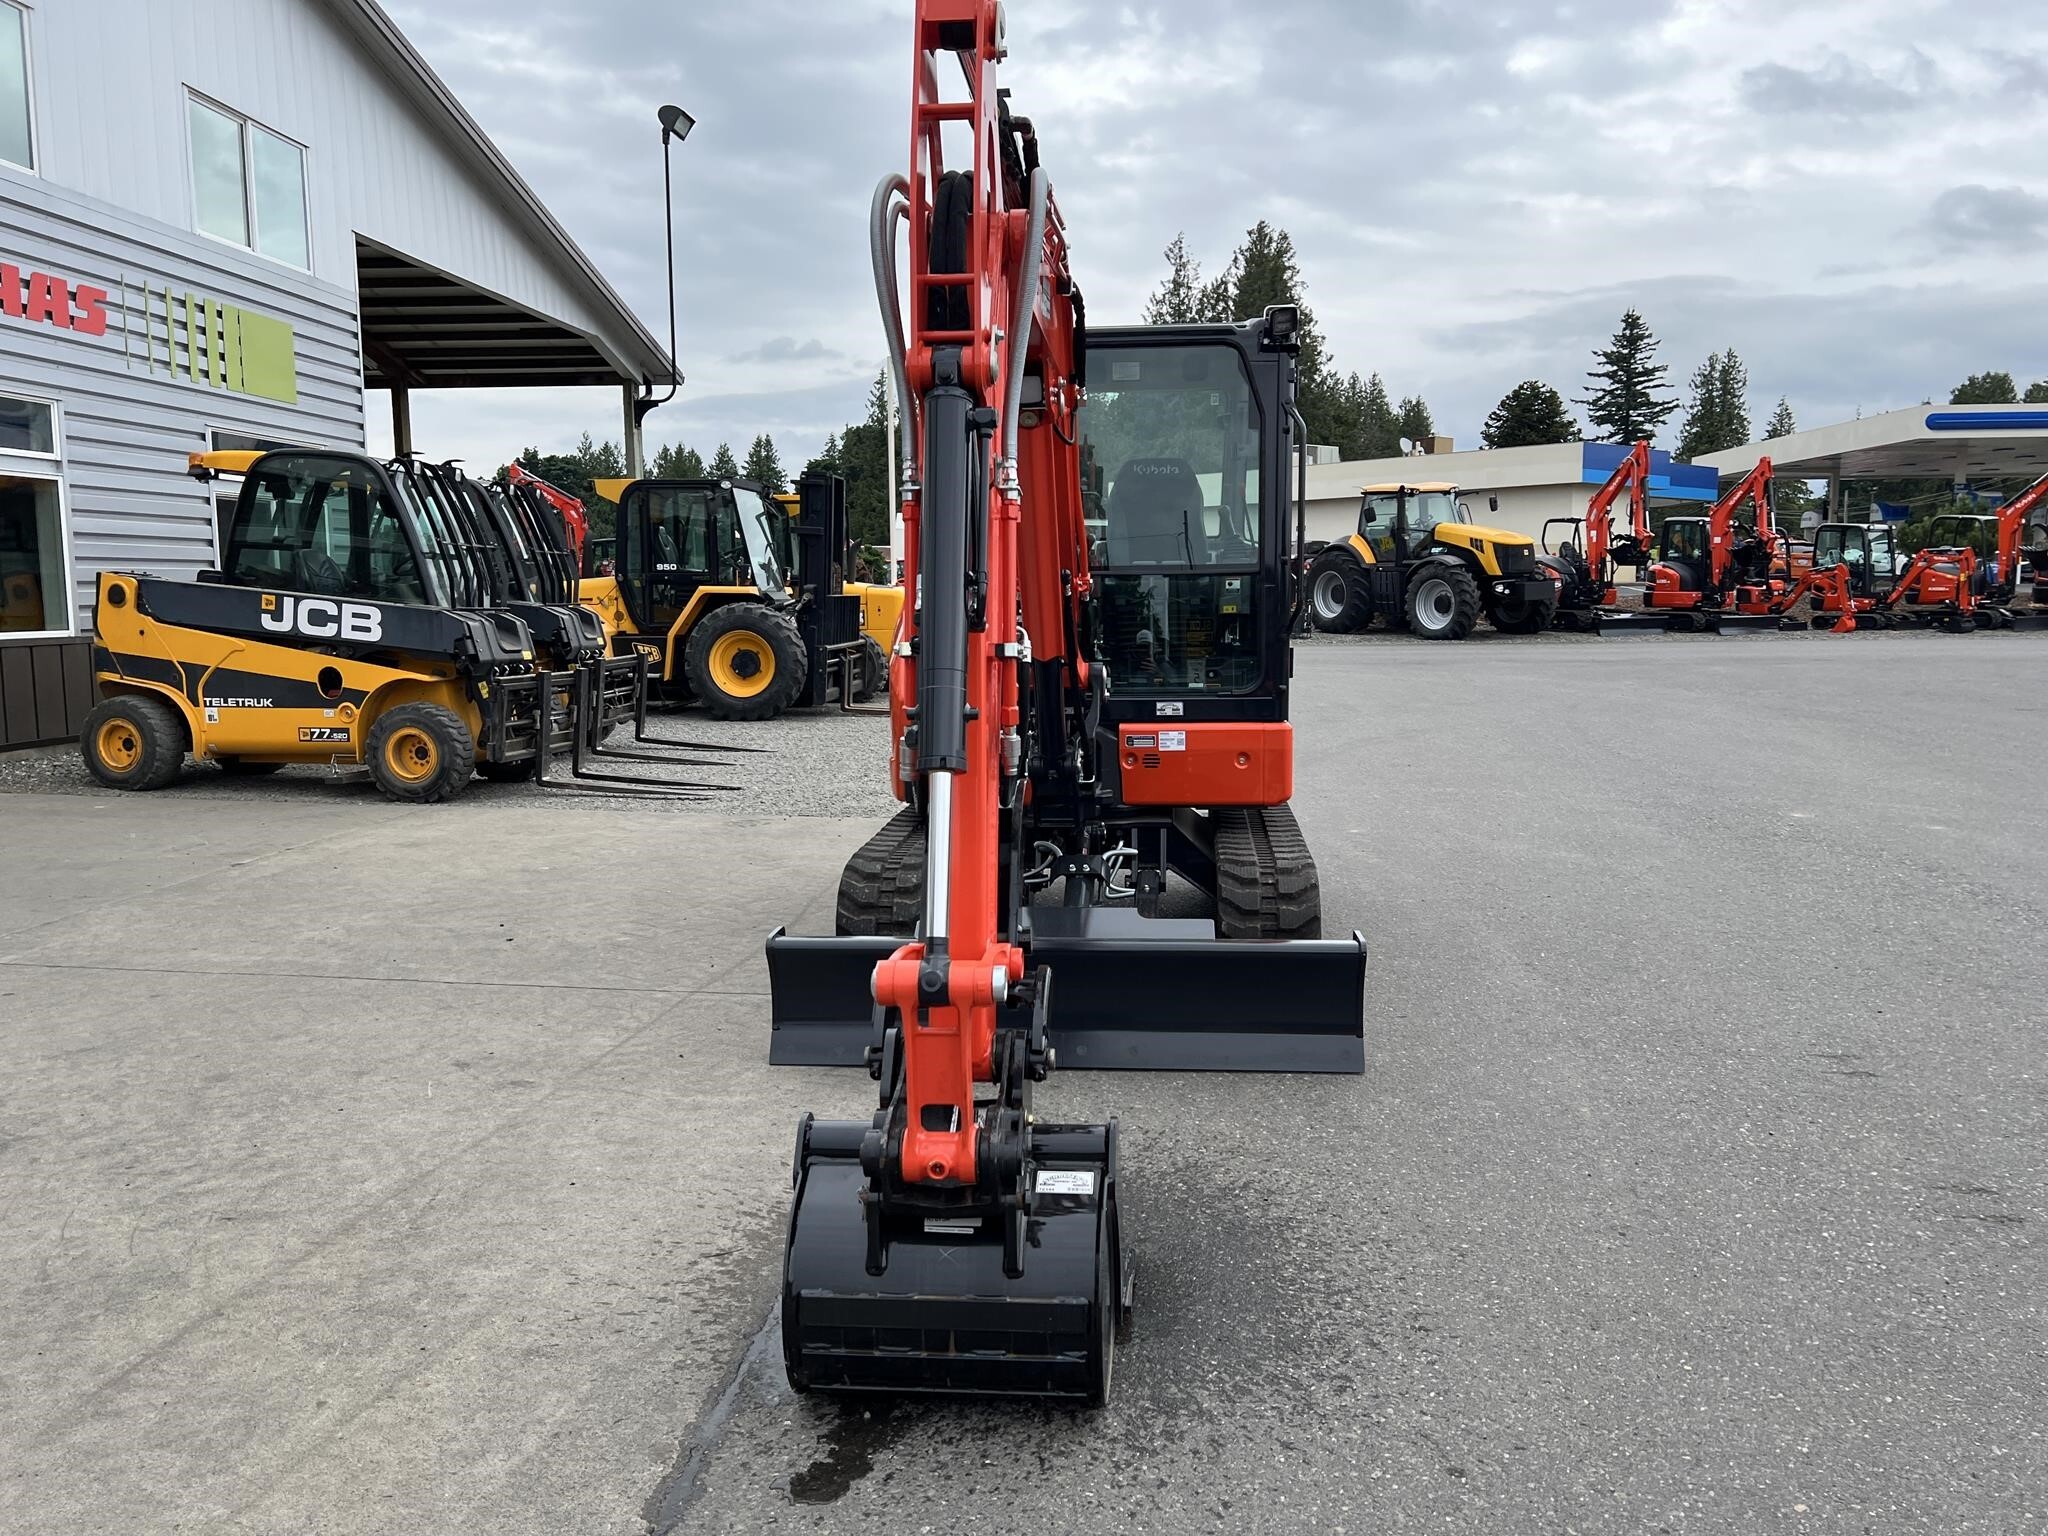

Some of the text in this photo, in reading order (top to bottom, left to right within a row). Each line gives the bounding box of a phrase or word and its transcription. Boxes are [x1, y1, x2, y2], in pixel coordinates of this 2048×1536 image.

[1133, 464, 1180, 474] Kubota
[656, 563, 677, 571] 950
[261, 596, 382, 642] JCB
[203, 697, 273, 707] TELETRUK
